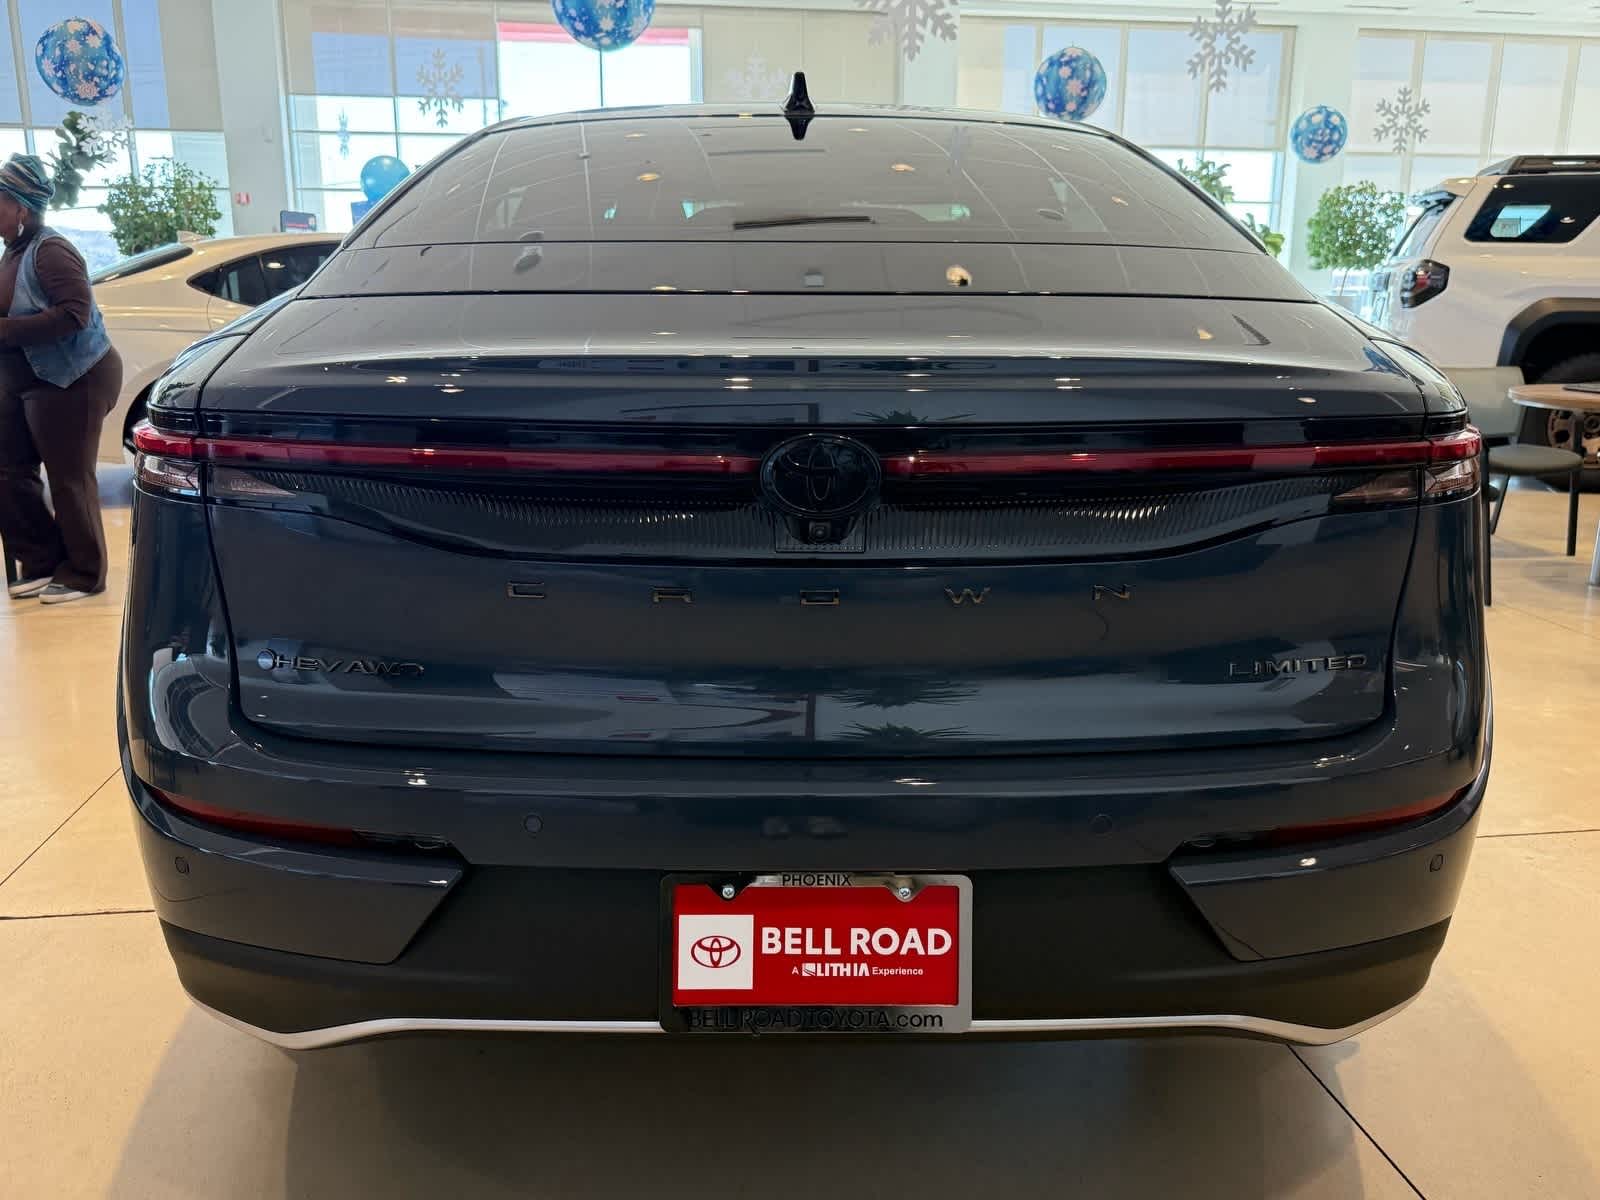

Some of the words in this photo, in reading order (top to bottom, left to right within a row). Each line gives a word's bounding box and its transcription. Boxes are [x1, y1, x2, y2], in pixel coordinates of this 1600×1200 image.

[505, 581, 1131, 606] CROWN
[1228, 654, 1368, 677] LIMITED
[782, 873, 852, 887] PHOENIX
[761, 927, 841, 954] BELL
[850, 928, 952, 955] ROAD
[791, 966, 799, 975] A
[816, 962, 870, 977] LITHIA
[872, 967, 924, 976] Experience
